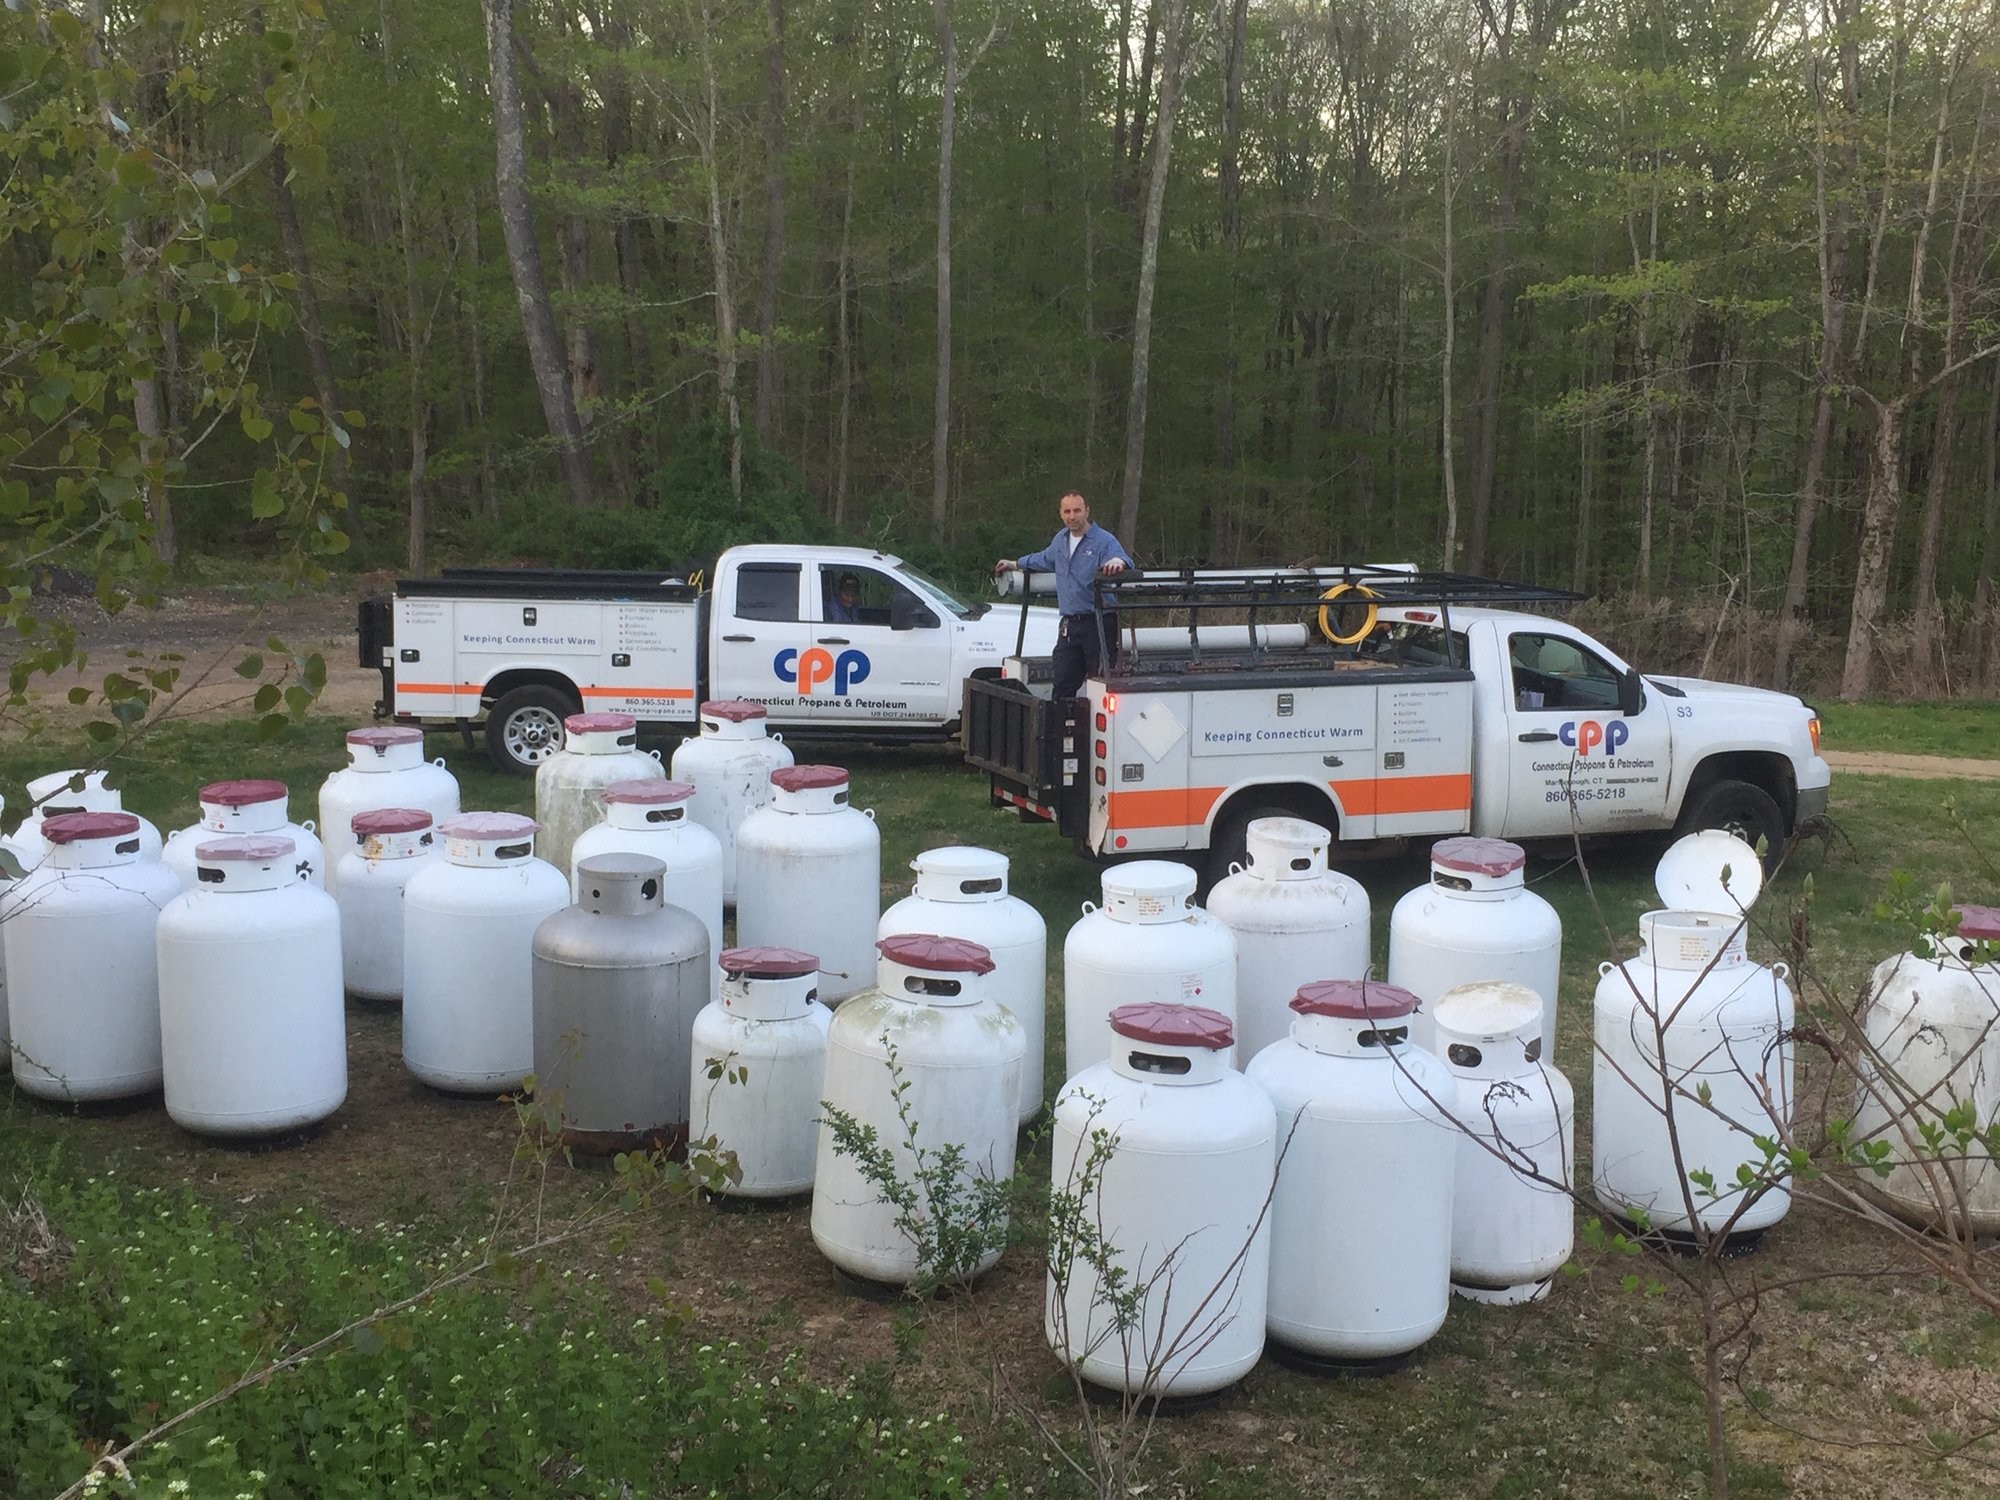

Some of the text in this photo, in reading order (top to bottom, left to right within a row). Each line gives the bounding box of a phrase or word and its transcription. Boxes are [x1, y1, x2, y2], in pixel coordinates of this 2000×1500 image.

[463, 634, 596, 646] Keeping Connecticut Warm
[799, 696, 841, 709] Propane
[844, 698, 852, 708] &
[855, 698, 907, 709] Petroleum
[1676, 706, 1693, 718] S3
[1204, 727, 1364, 743] Keeping Connecticut Warm
[1532, 758, 1654, 772] Connecticu Propane & Petroleum
[1592, 777, 1602, 785] CT
[1545, 787, 1626, 803] 860365-5218
